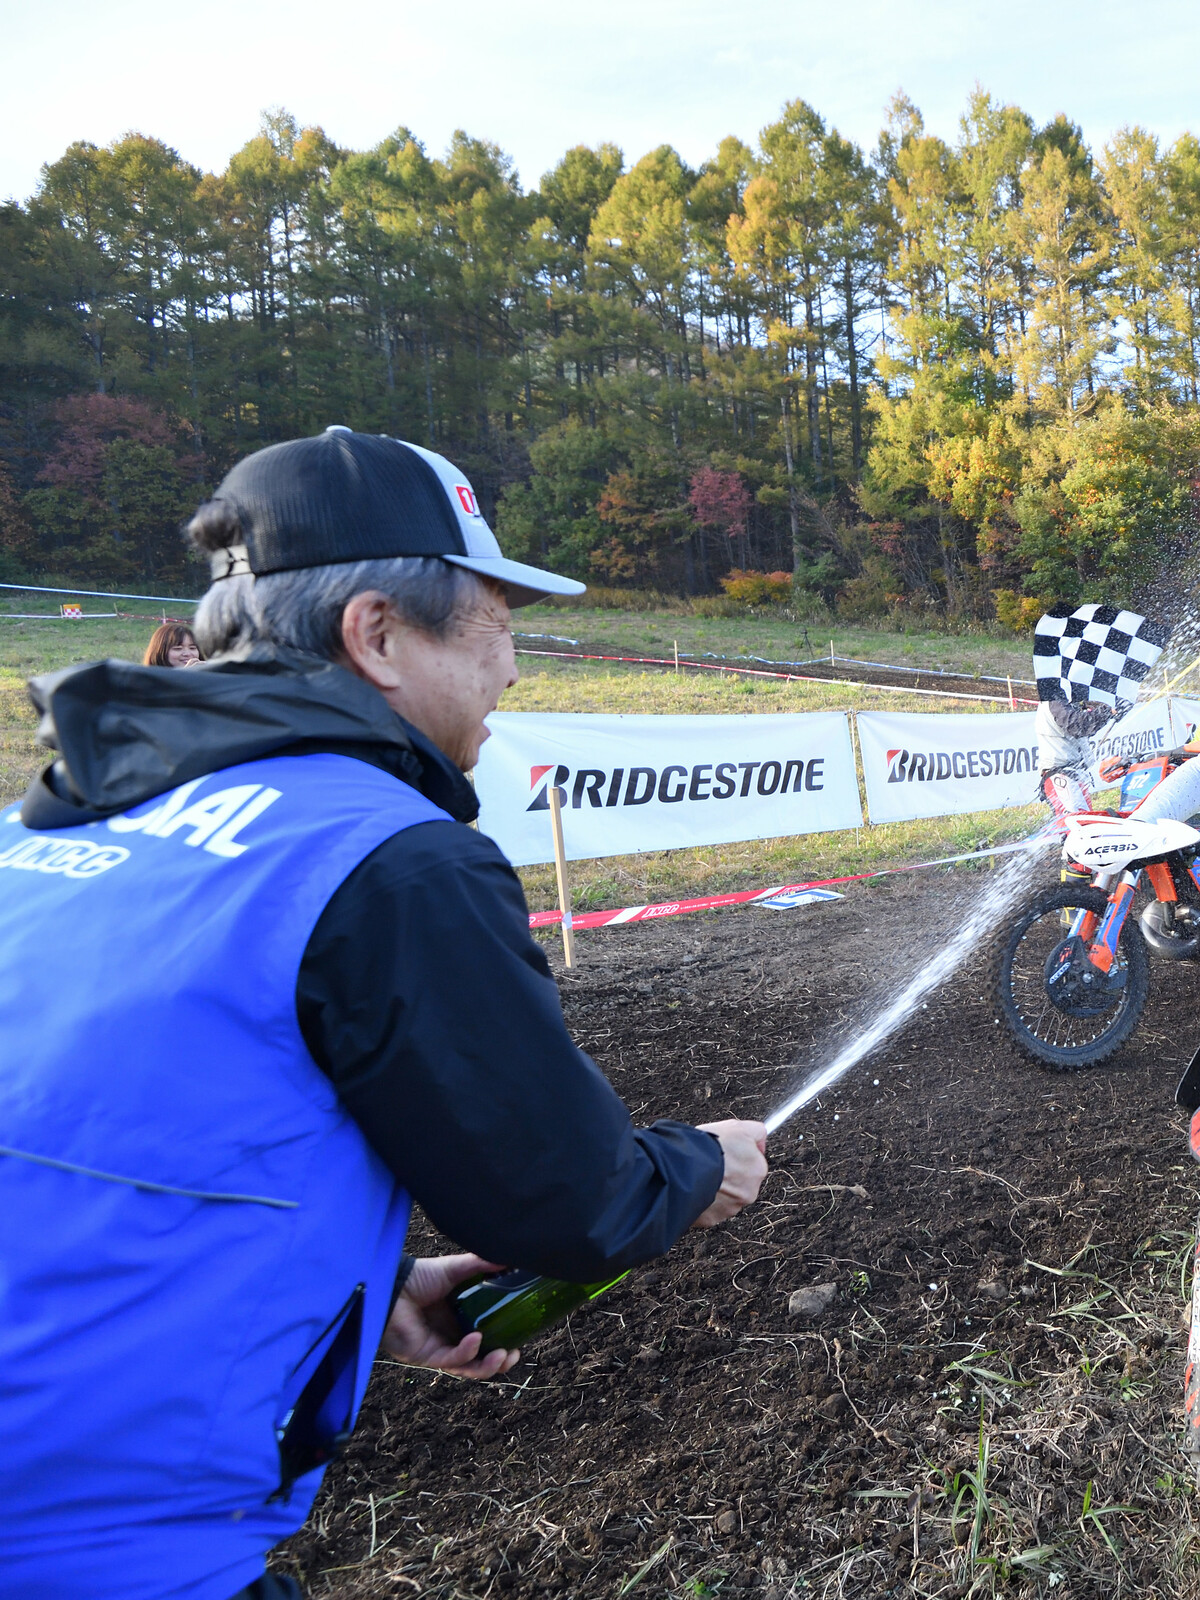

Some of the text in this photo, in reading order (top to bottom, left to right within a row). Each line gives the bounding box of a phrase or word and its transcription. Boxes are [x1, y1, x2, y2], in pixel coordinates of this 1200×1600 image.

[1089, 727, 1165, 762] RIDGESTONE
[886, 746, 1040, 784] BRIDGESTONE
[526, 758, 825, 812] BRIDGESTONE
[1084, 843, 1139, 856] ACERBIS
[641, 903, 680, 919] JNCC
